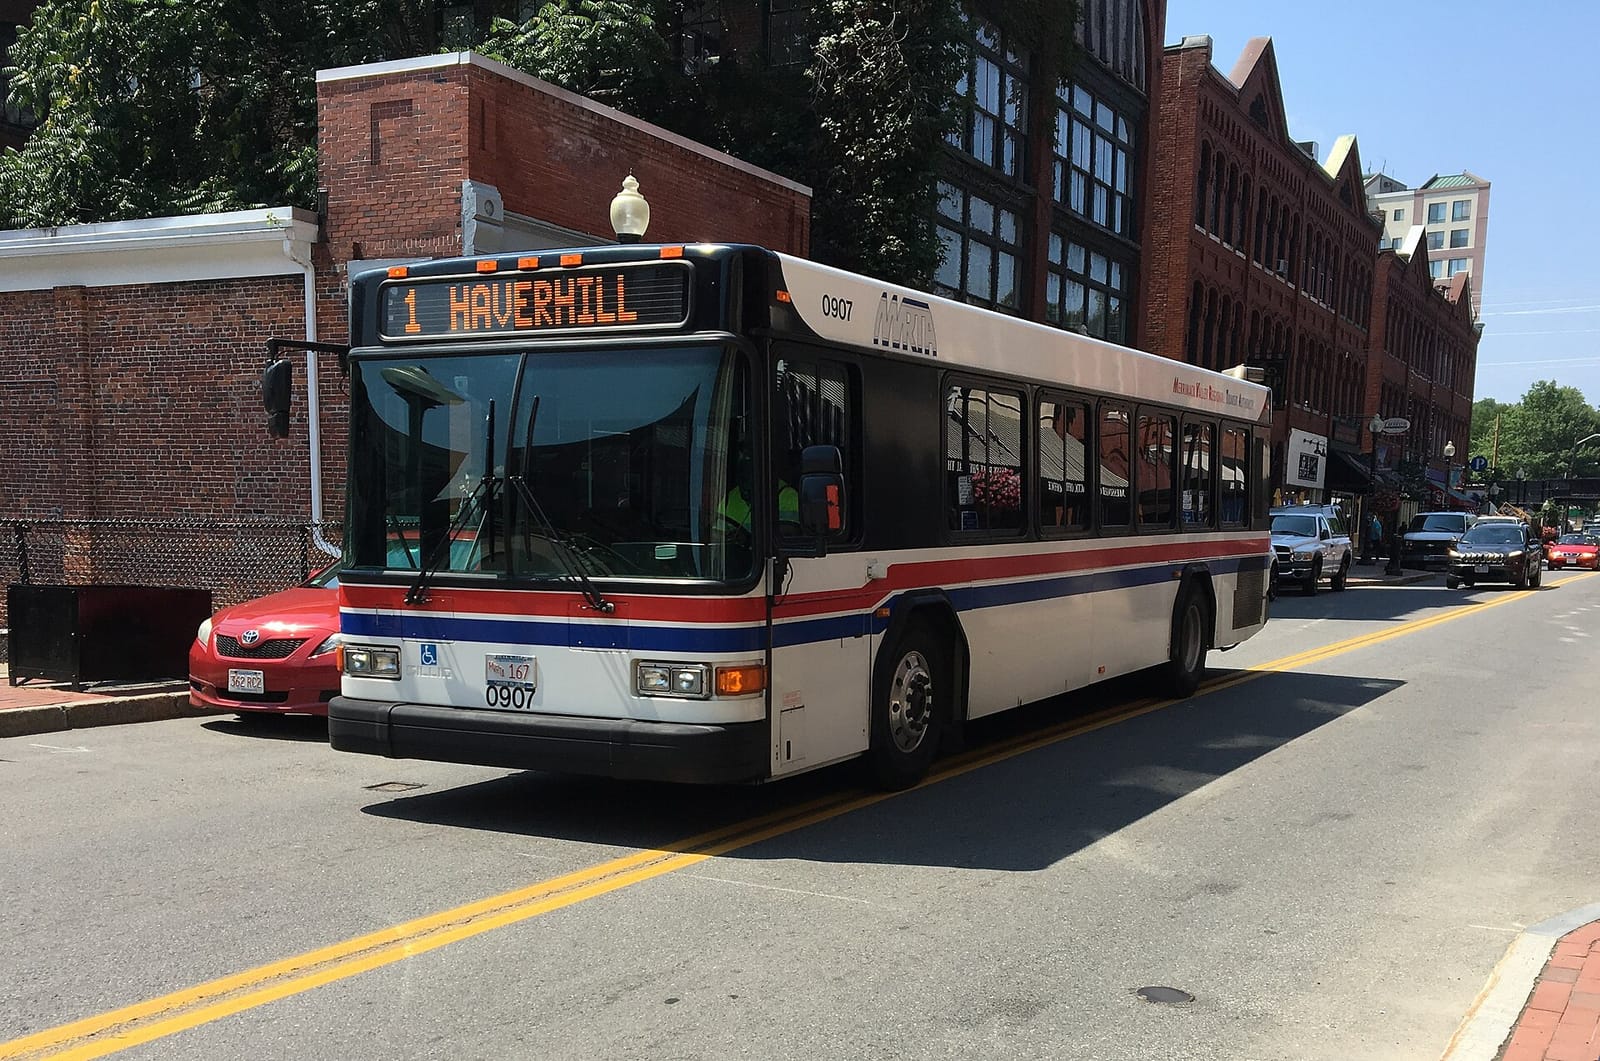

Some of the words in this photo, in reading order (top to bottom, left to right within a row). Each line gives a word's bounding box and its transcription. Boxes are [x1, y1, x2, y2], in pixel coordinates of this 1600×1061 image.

[404, 289, 421, 333] 1
[450, 275, 638, 330] HAVERHILL
[822, 294, 853, 322] 0907
[1475, 458, 1485, 470] P
[508, 663, 530, 679] 167
[230, 676, 246, 688] 362
[486, 685, 536, 709] 0907
